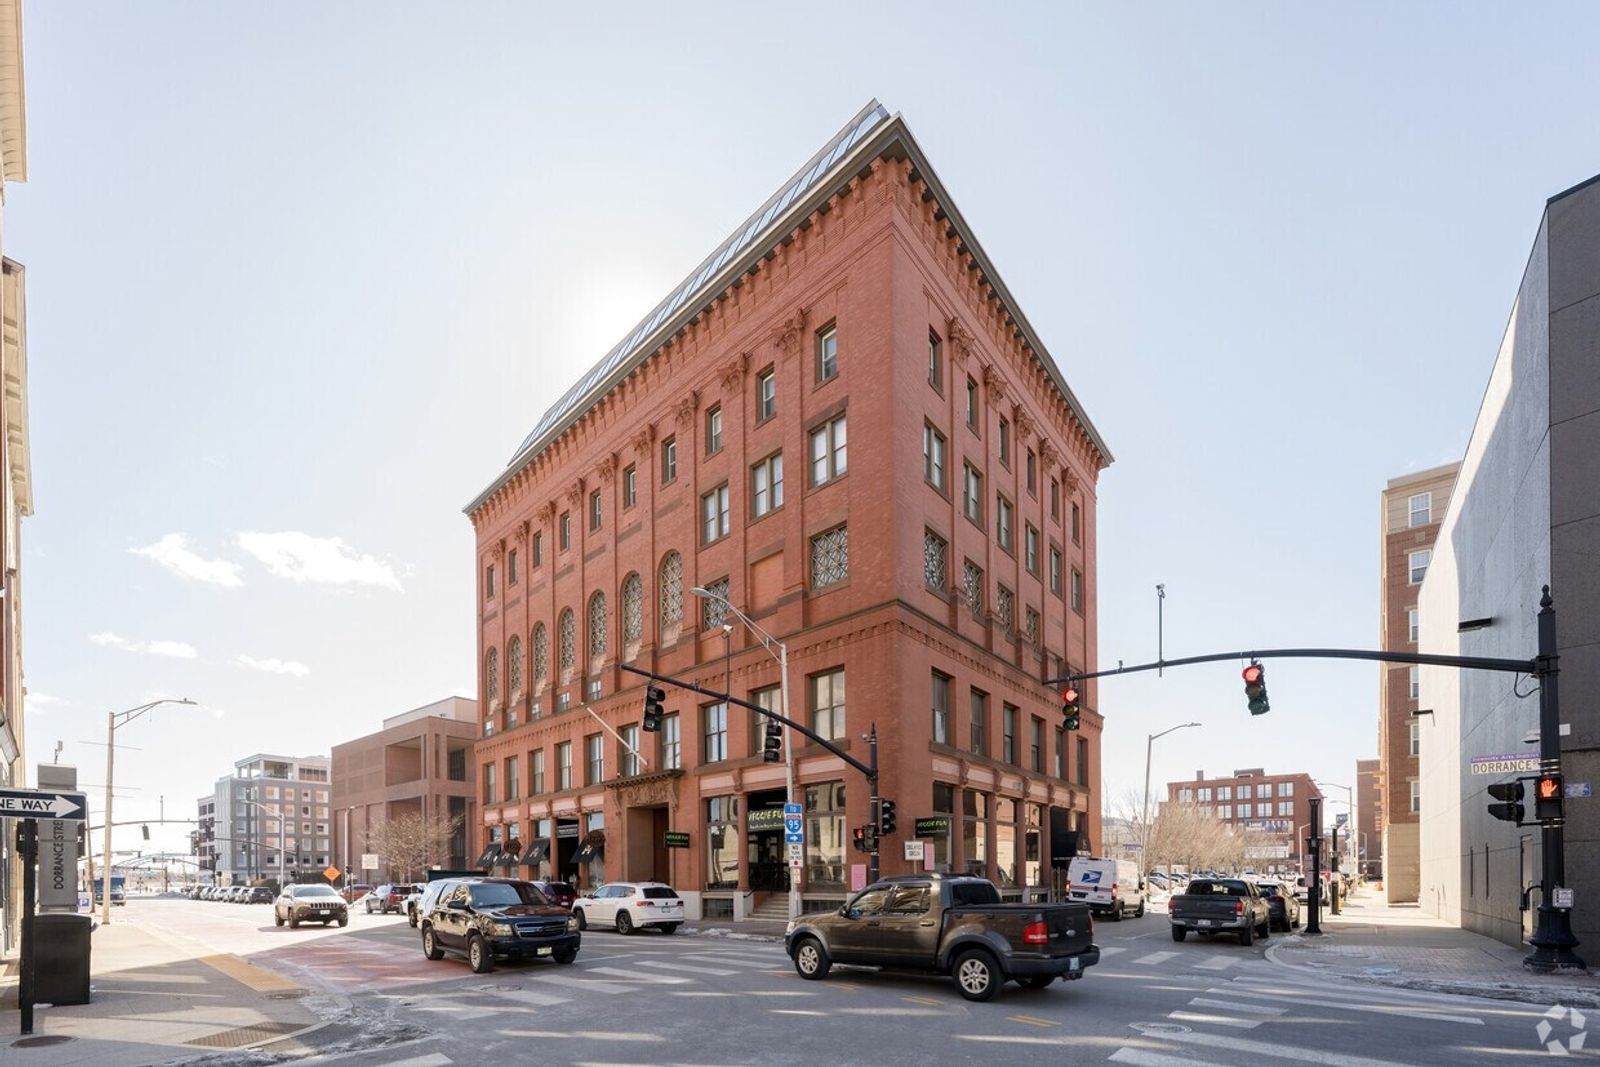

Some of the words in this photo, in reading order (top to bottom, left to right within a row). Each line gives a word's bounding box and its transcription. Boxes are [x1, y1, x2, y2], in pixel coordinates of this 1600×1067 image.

[1473, 760, 1532, 774] DORRANCE
[0, 798, 16, 809] NE
[21, 799, 53, 811] WAY
[53, 819, 64, 840] STRE
[788, 819, 800, 830] 95
[53, 842, 64, 889] DORRANCE
